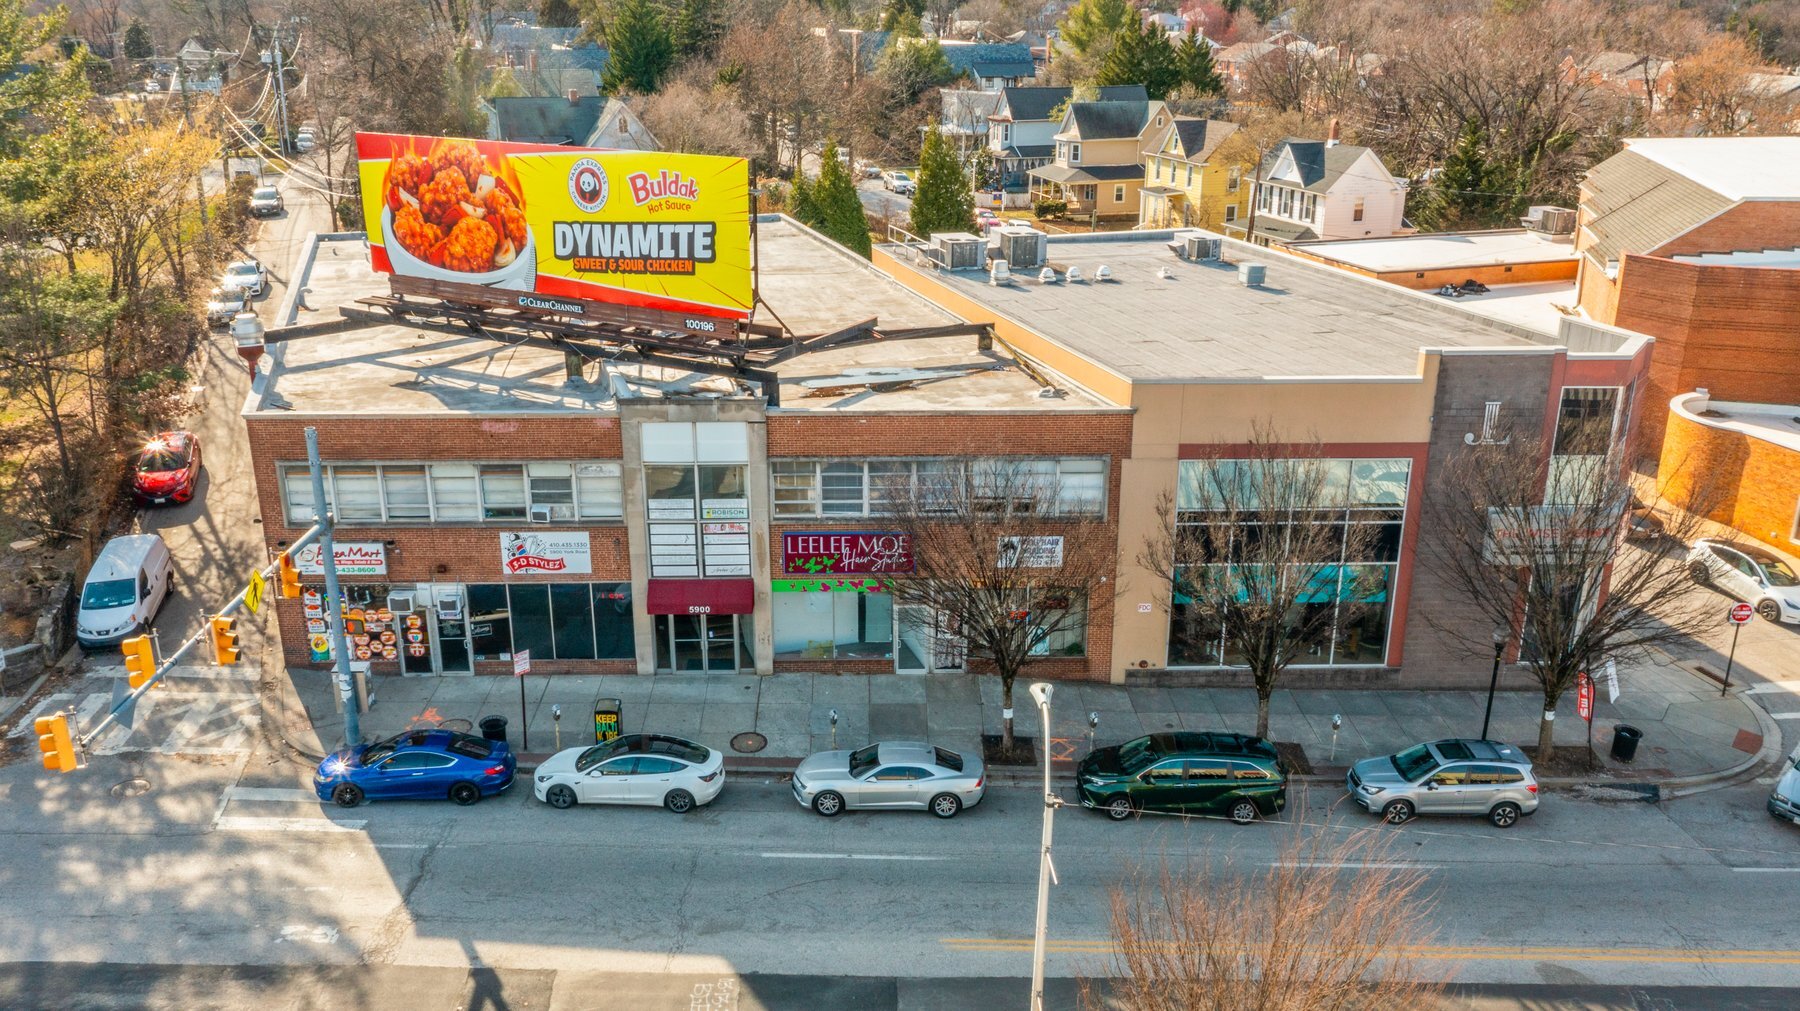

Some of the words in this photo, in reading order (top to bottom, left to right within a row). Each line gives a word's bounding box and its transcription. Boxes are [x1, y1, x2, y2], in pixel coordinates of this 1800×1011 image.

[570, 161, 585, 181] PANDA
[586, 160, 607, 185] EXPRESS
[628, 170, 698, 205] Buldak
[571, 191, 589, 211] CHINESE
[589, 194, 607, 211] KITCHEN
[647, 203, 663, 215] Hot
[665, 200, 692, 212] Sauce
[554, 223, 713, 259] DYNAMITE
[573, 258, 607, 271] SWEET
[608, 259, 617, 271] &
[618, 259, 645, 272] SOUR
[646, 260, 693, 273] CHICKEN
[685, 319, 715, 332] 100196
[347, 546, 382, 558] Mart
[787, 536, 851, 554] LEELEE
[857, 536, 908, 554] MOE
[528, 557, 561, 569] STYLEZ
[840, 547, 871, 571] Hair
[689, 605, 711, 614] 5900
[596, 714, 617, 723] KEEP
